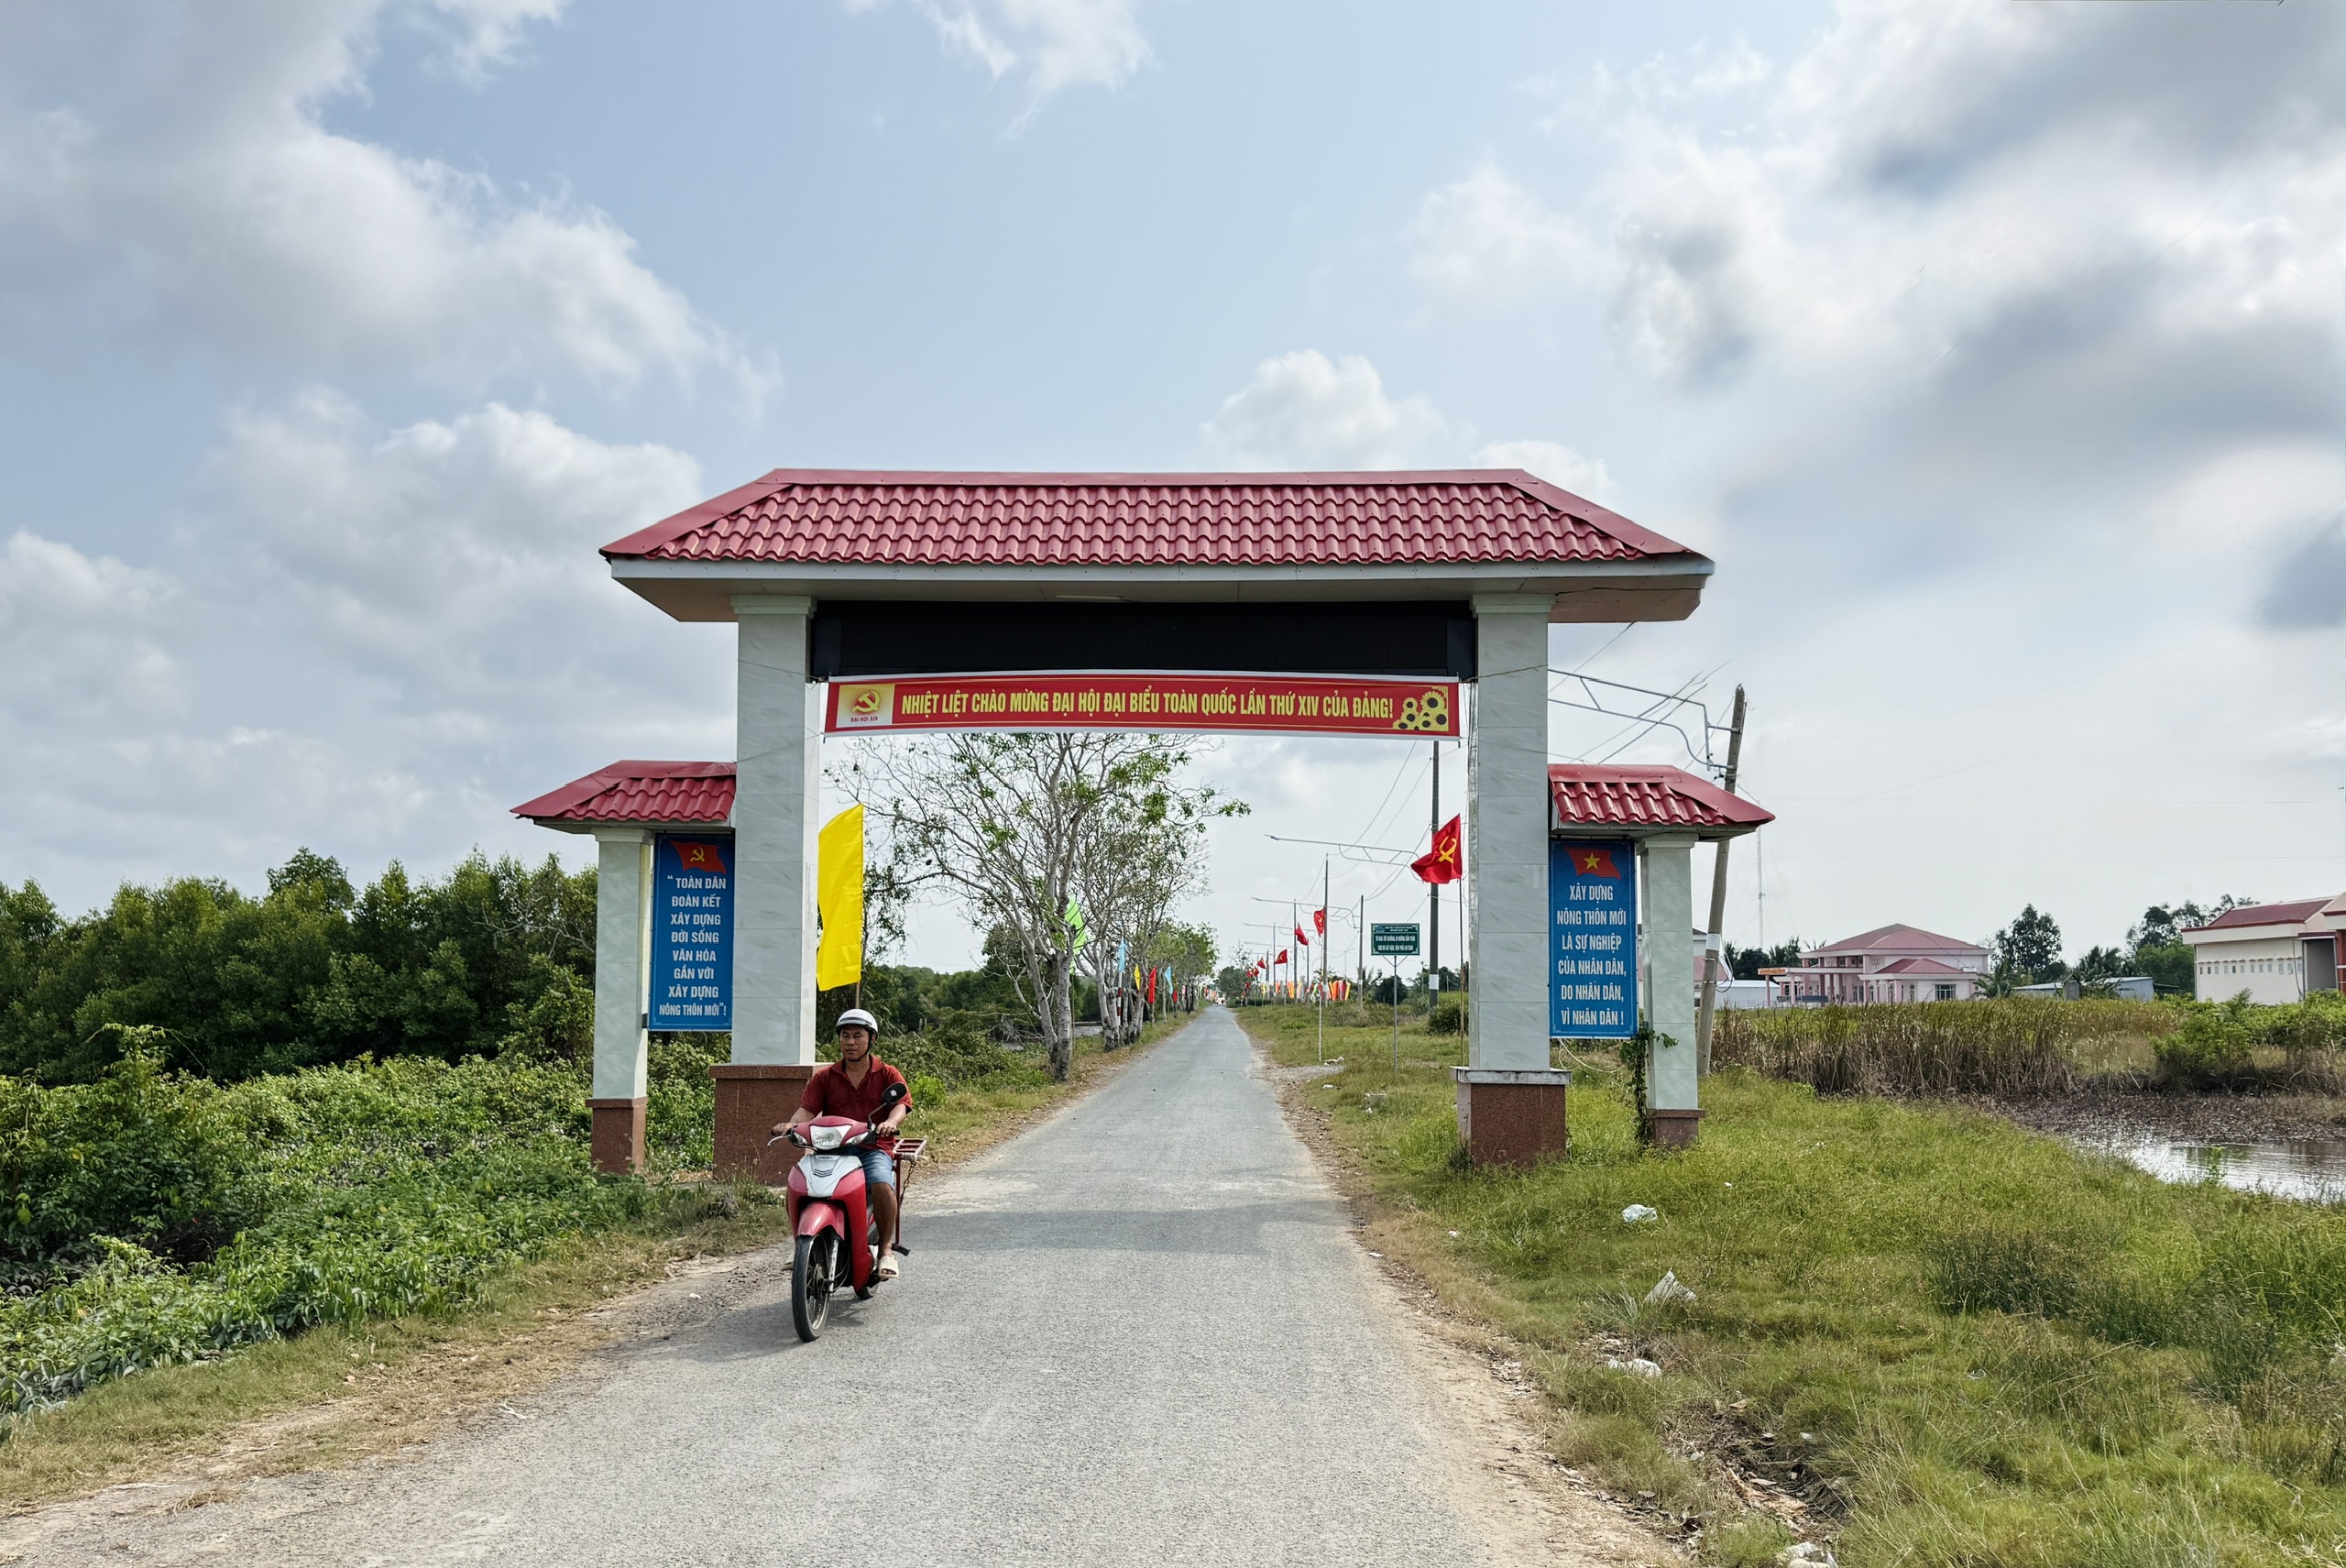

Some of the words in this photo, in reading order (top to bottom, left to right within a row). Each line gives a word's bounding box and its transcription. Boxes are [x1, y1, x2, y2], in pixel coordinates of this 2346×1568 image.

[901, 691, 940, 718] NHIỆT
[942, 689, 970, 717] LIỆT
[971, 689, 1007, 713] CHÀO
[1009, 688, 1049, 712] MỪNG
[1052, 692, 1075, 717] ĐẠI
[1078, 688, 1101, 717] HỘI
[1102, 692, 1126, 717] ĐẠI
[1129, 685, 1160, 712] BIỂU
[1163, 688, 1198, 713] TOÀN
[1200, 686, 1237, 716] QUỐC
[1240, 687, 1266, 716] LẦN
[1268, 693, 1297, 716] THỨ
[1298, 695, 1320, 717] XIV
[1322, 689, 1350, 718] CỦA
[1352, 690, 1394, 718] ĐẢNG!
[675, 875, 703, 889] TOÀN
[705, 875, 727, 889] DÂN
[671, 894, 700, 907] ĐOÀN
[702, 893, 721, 907] KẾT
[1569, 883, 1587, 901] XÂY
[1589, 884, 1614, 904] DỰNG
[670, 913, 690, 926] XÂY
[693, 913, 721, 927] DỰNG
[1556, 907, 1582, 926] NÔNG
[1584, 907, 1607, 926] THÔN
[1609, 907, 1627, 926] MỚI
[671, 928, 689, 943] ĐỜI
[691, 927, 719, 944] SỐNG
[1562, 931, 1573, 950] LÀ
[1575, 933, 1589, 953] SỰ
[1589, 932, 1622, 954] NGHIỆP
[673, 948, 694, 961] VĂN
[696, 948, 717, 962] HÓA
[674, 964, 696, 980] GẮN
[697, 965, 715, 980] VỚI
[1558, 955, 1576, 975] CỦA
[1578, 957, 1604, 975] NHÂN
[1605, 957, 1627, 977] DÂN,
[668, 983, 688, 998] XÂY
[690, 985, 719, 1001] DỰNG
[1561, 984, 1573, 1001] DO
[1575, 981, 1601, 1001] NHÂN
[1603, 981, 1624, 1003] DÂN,
[659, 1002, 681, 1016] NÔNG
[682, 1003, 703, 1016] THÔN
[1561, 1007, 1571, 1025] VÌ
[1572, 1007, 1597, 1025] NHÂN
[1598, 1007, 1619, 1025] DÂN
